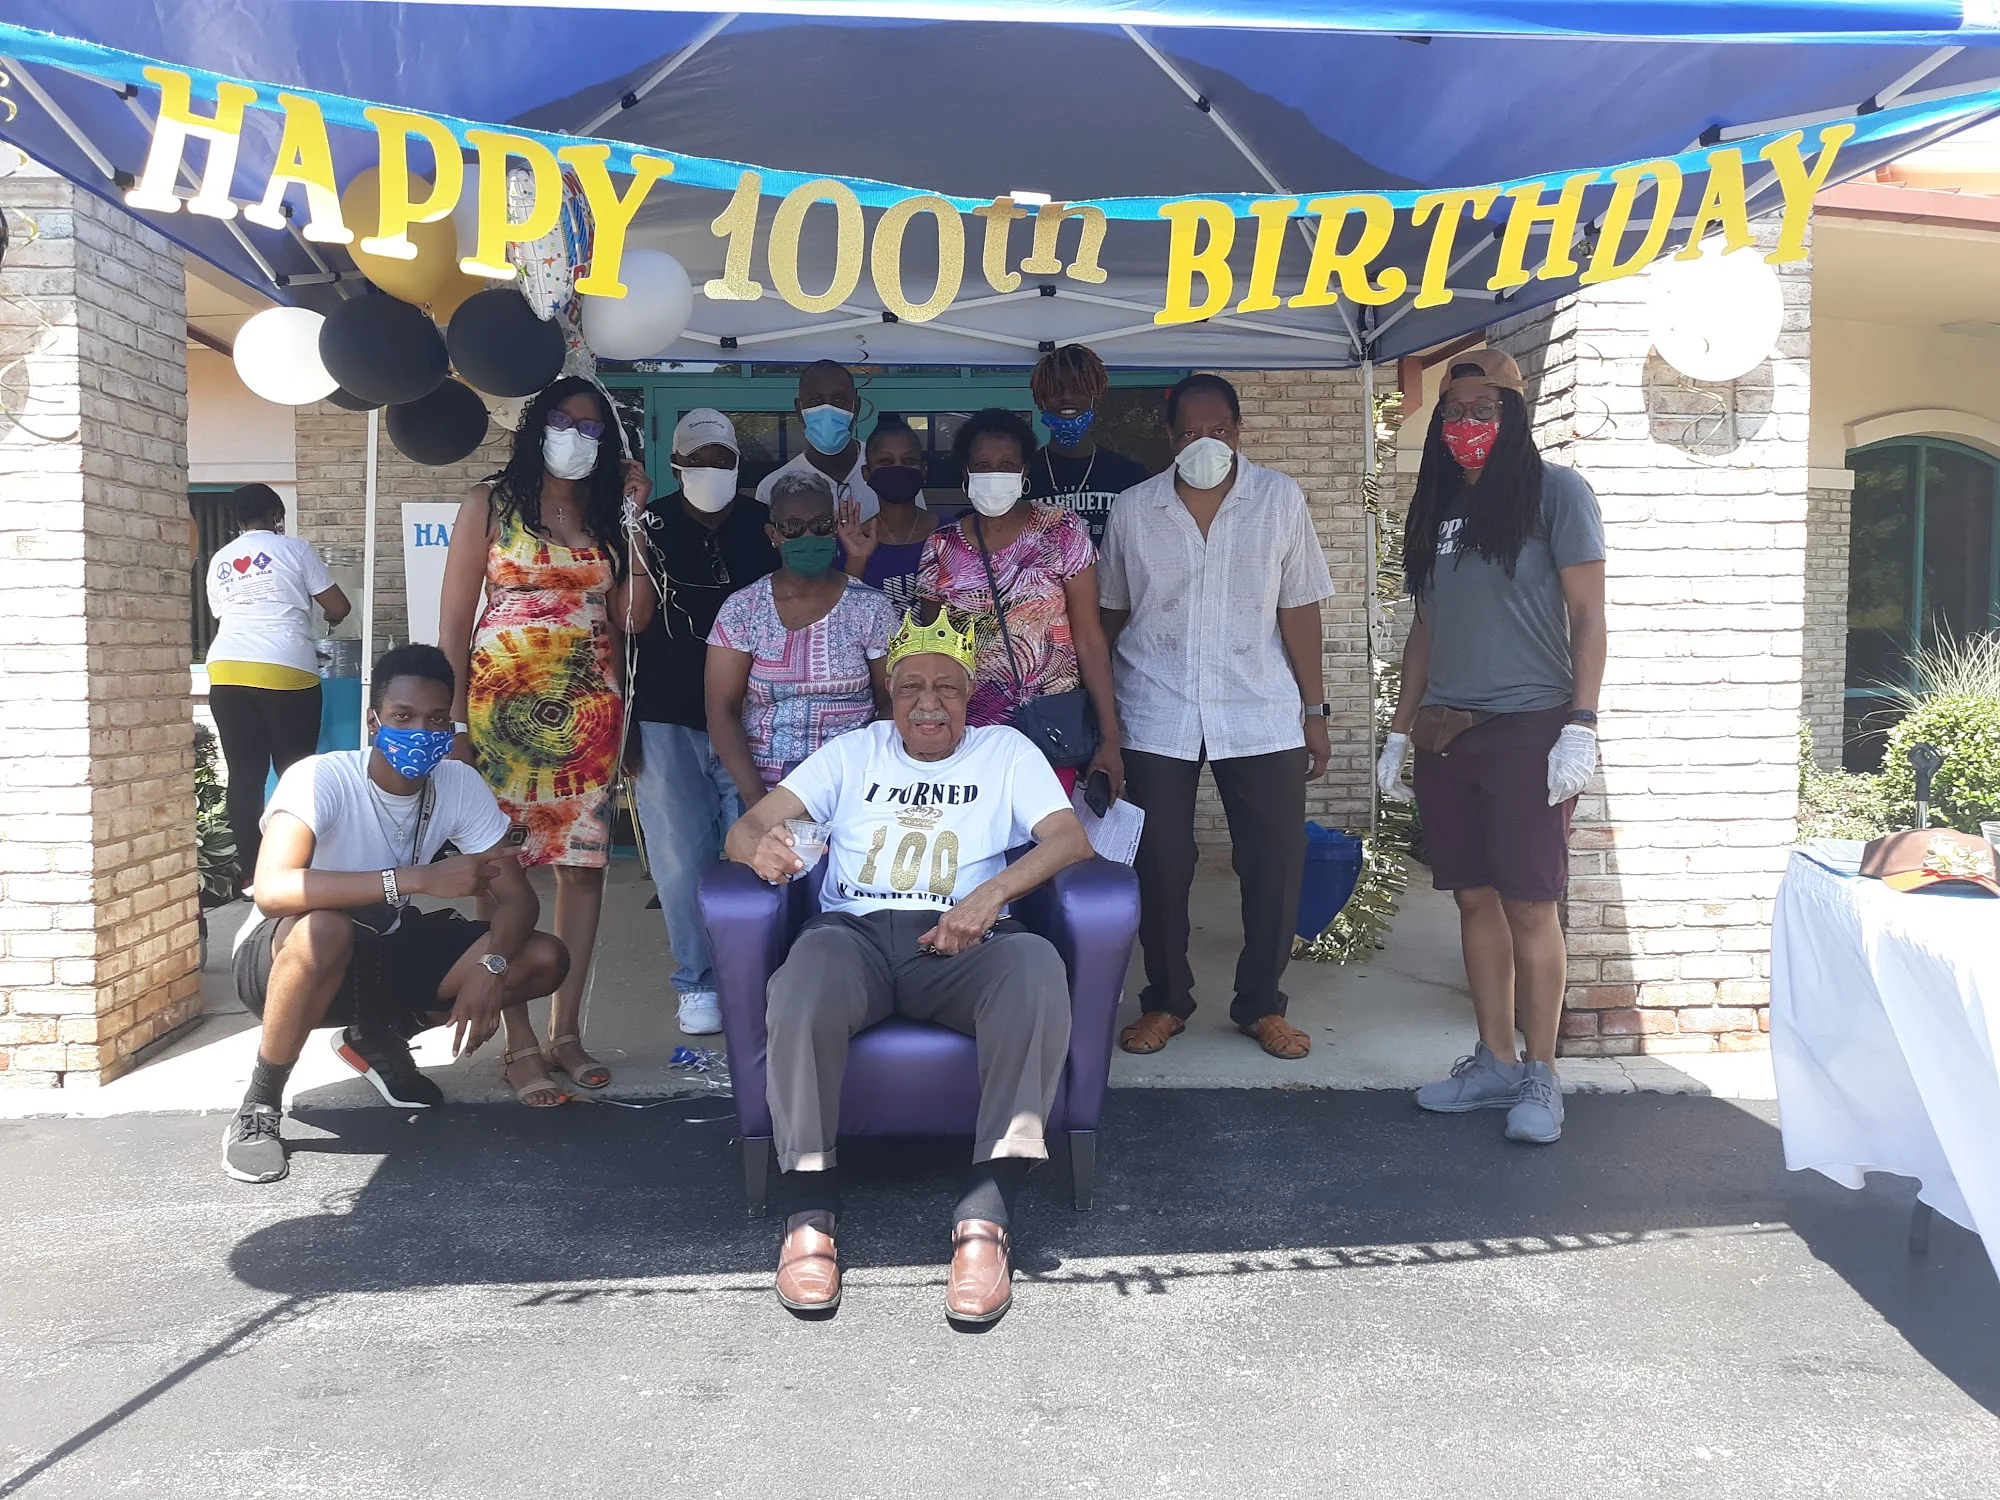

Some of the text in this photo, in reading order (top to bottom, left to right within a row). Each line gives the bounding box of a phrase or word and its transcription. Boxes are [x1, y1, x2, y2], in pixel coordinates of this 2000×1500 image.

[124, 66, 1856, 325] HAPPY 100th BIRTHDAY
[1031, 491, 1120, 511] ARQUETT
[413, 523, 455, 547] HA
[864, 782, 979, 806] I TURNED
[857, 825, 959, 896] 100
